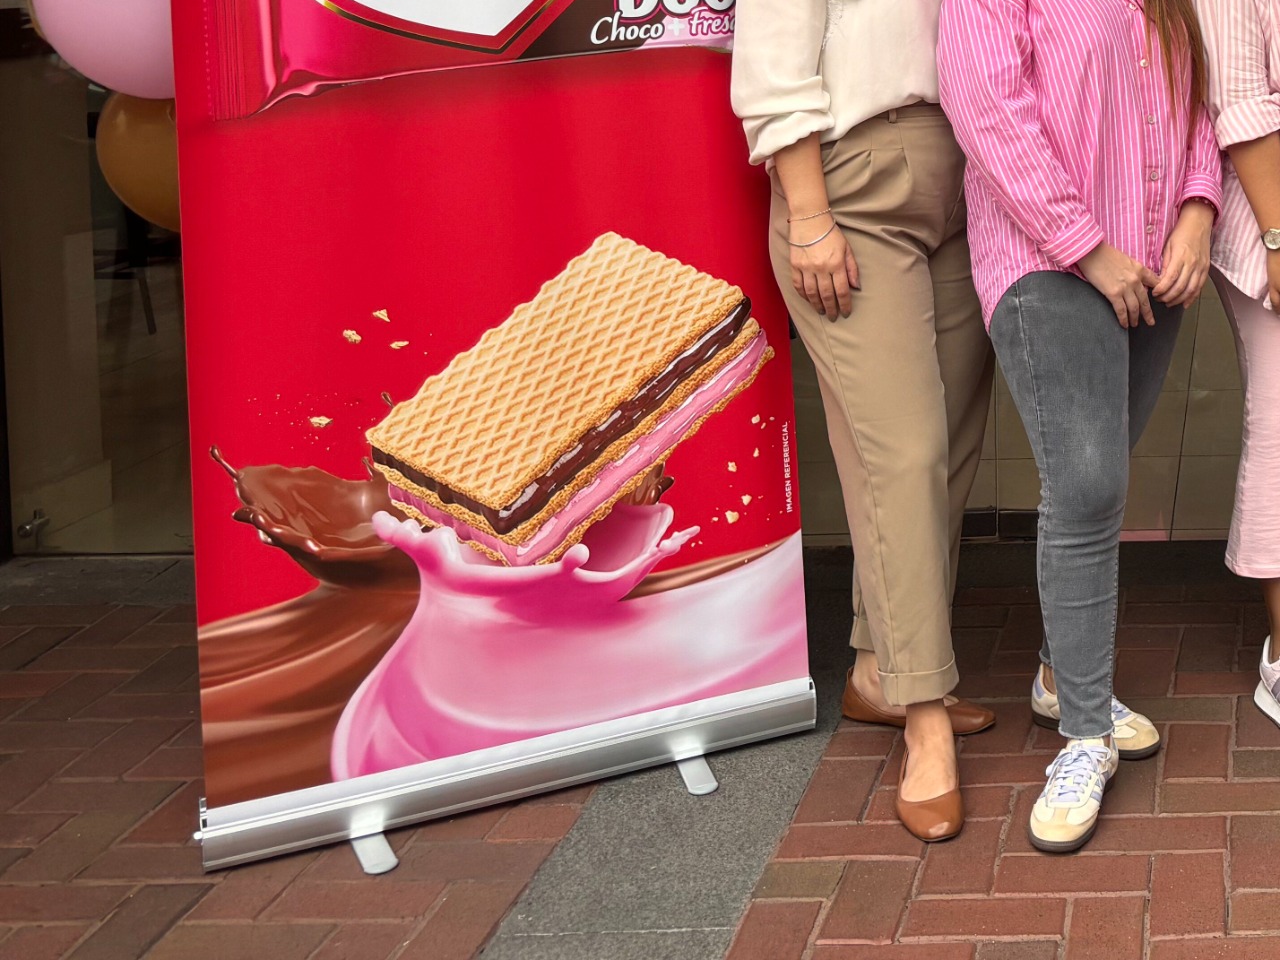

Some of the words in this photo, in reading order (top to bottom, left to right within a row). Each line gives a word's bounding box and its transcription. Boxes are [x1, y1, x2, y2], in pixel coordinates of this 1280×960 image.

[589, 11, 663, 43] Choco
[781, 421, 791, 479] REFERENCIAL
[784, 480, 793, 513] IMAGEN
